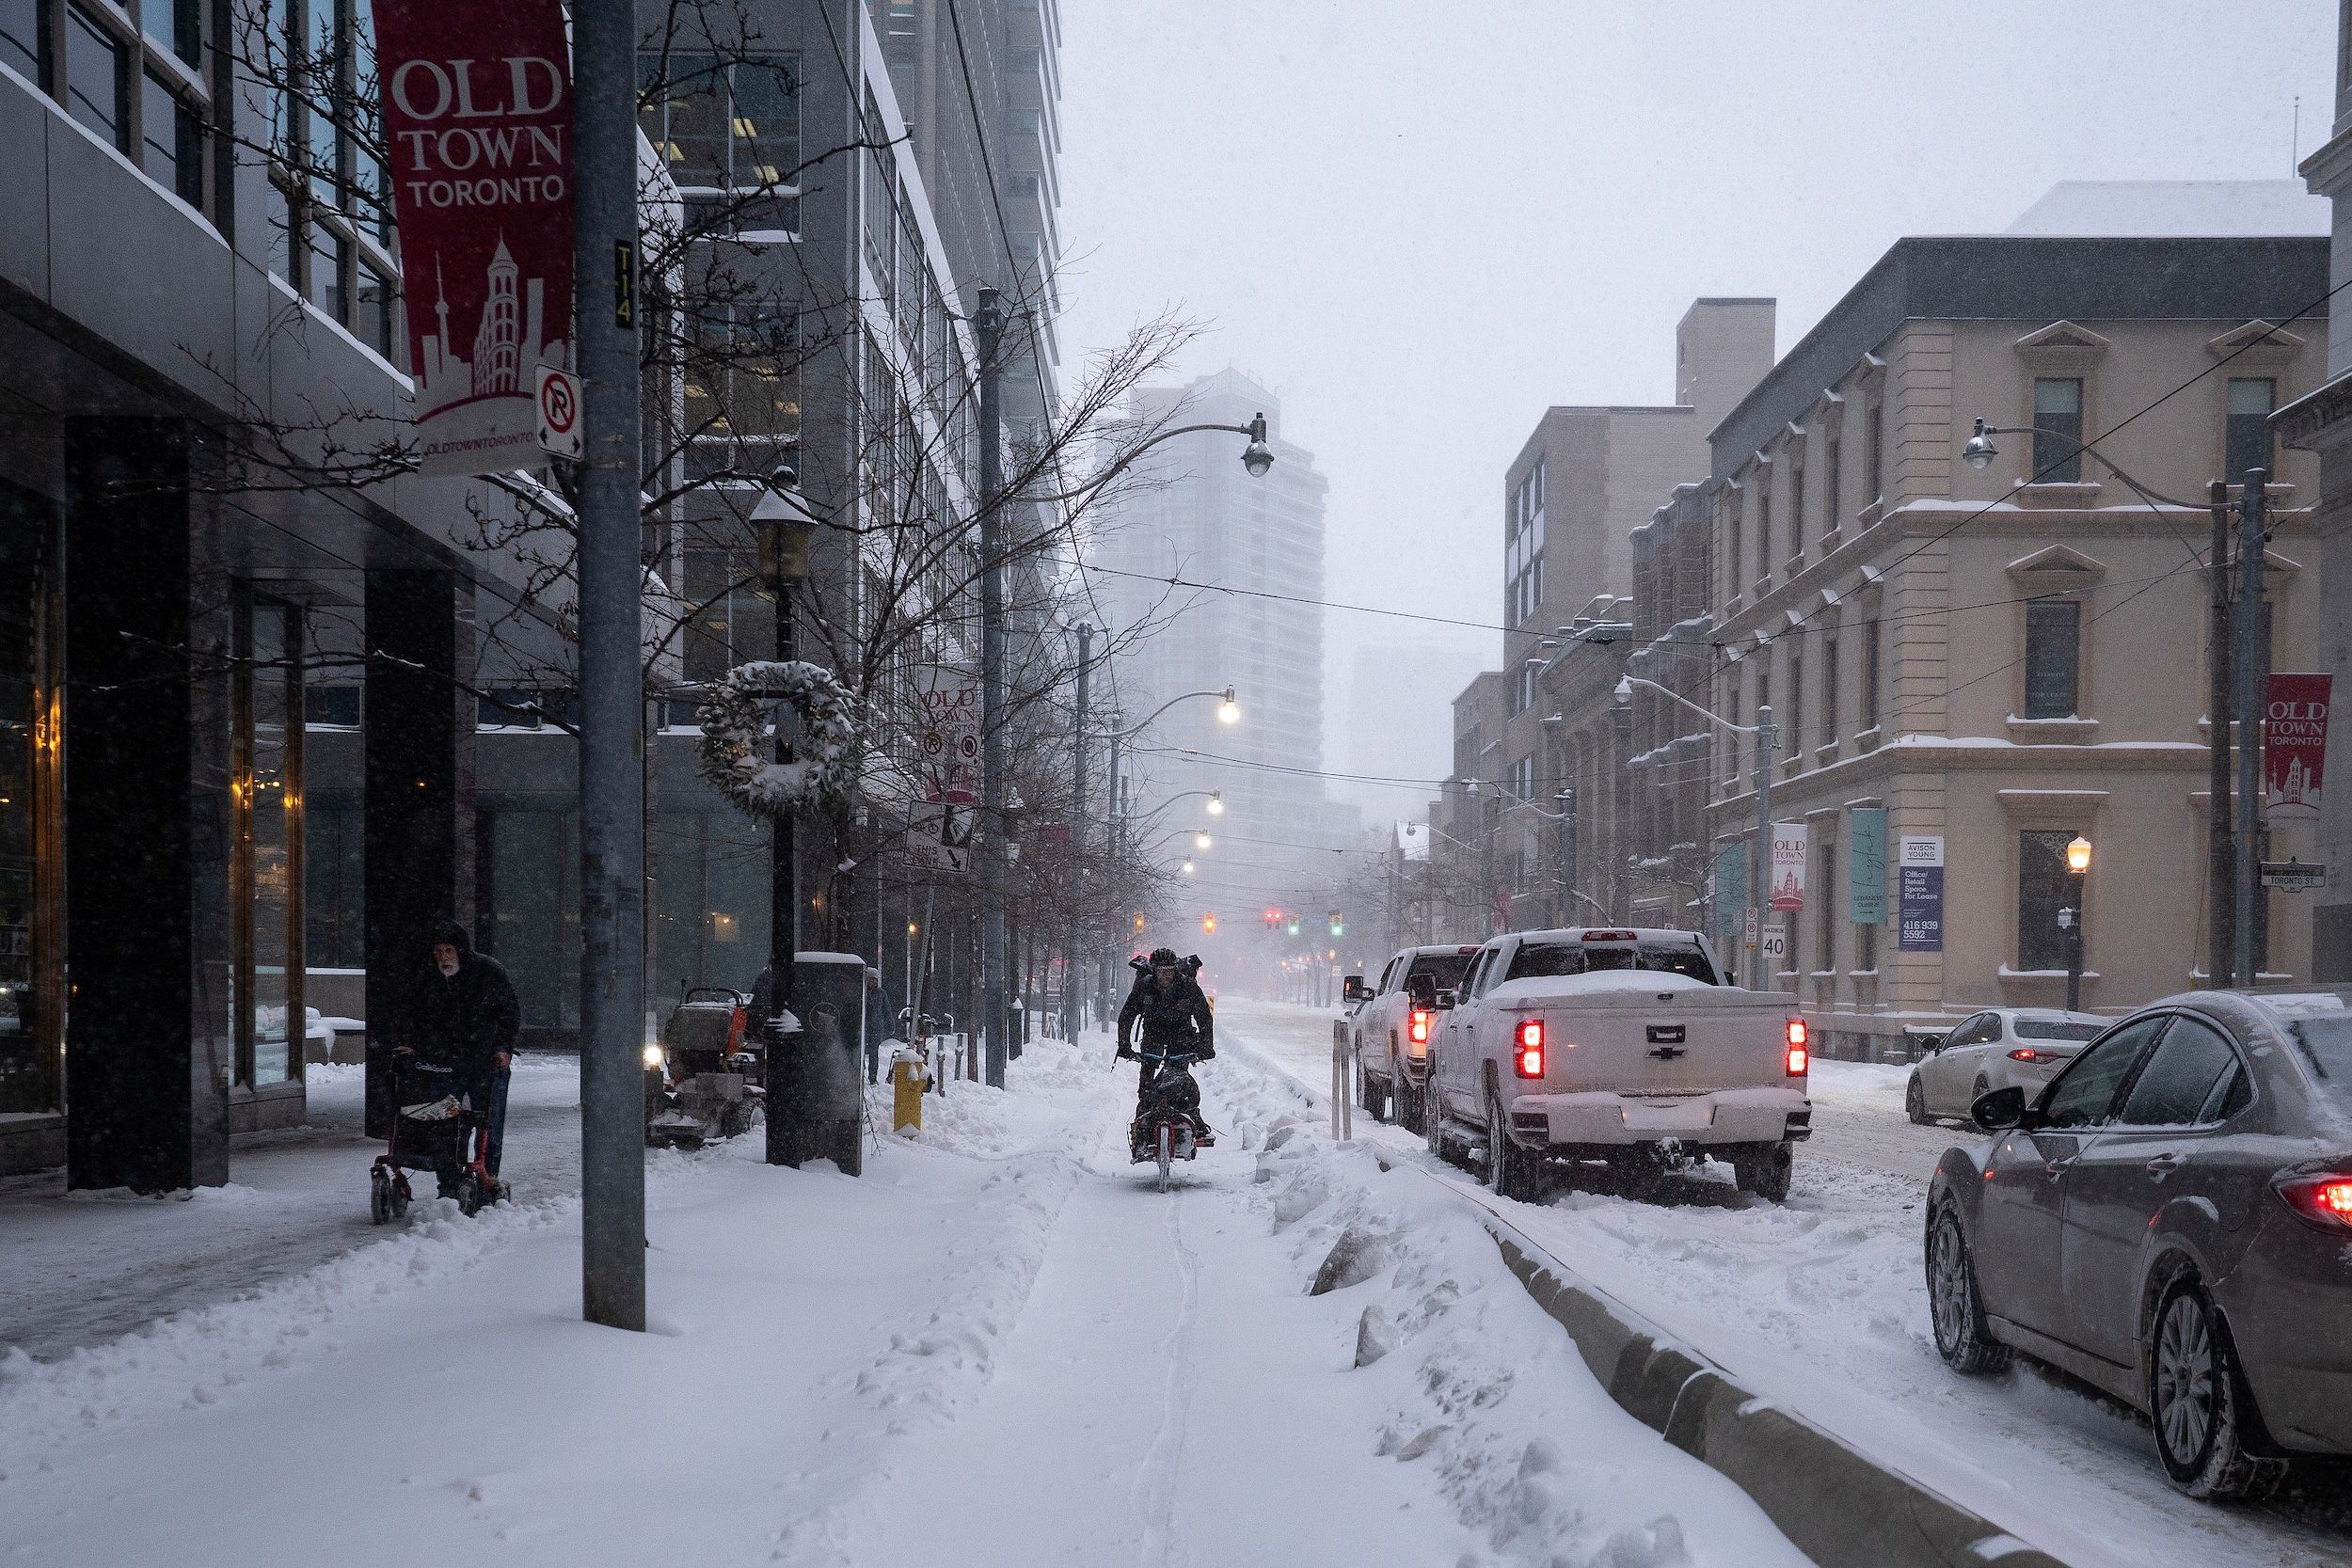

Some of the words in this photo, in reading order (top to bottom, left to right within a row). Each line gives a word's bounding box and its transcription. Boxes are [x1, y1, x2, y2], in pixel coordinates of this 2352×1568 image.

[391, 56, 564, 120] OLD
[397, 124, 565, 170] TOWN
[405, 175, 564, 208] TORONTO
[616, 245, 631, 322] T14
[922, 689, 976, 708] OLD
[2268, 701, 2327, 721] OLD
[2268, 721, 2325, 735] TOWN
[2268, 736, 2322, 746] TORONTO
[916, 845, 938, 855] THIS
[1774, 840, 1805, 851] OLD
[1774, 851, 1804, 860] TOWN
[2271, 877, 2302, 885] TORONTO
[1904, 885, 1927, 894] Space
[1903, 921, 1920, 930] 416
[1921, 921, 1938, 930] 939
[1903, 929, 1926, 939] 5592
[1763, 939, 1784, 955] 40
